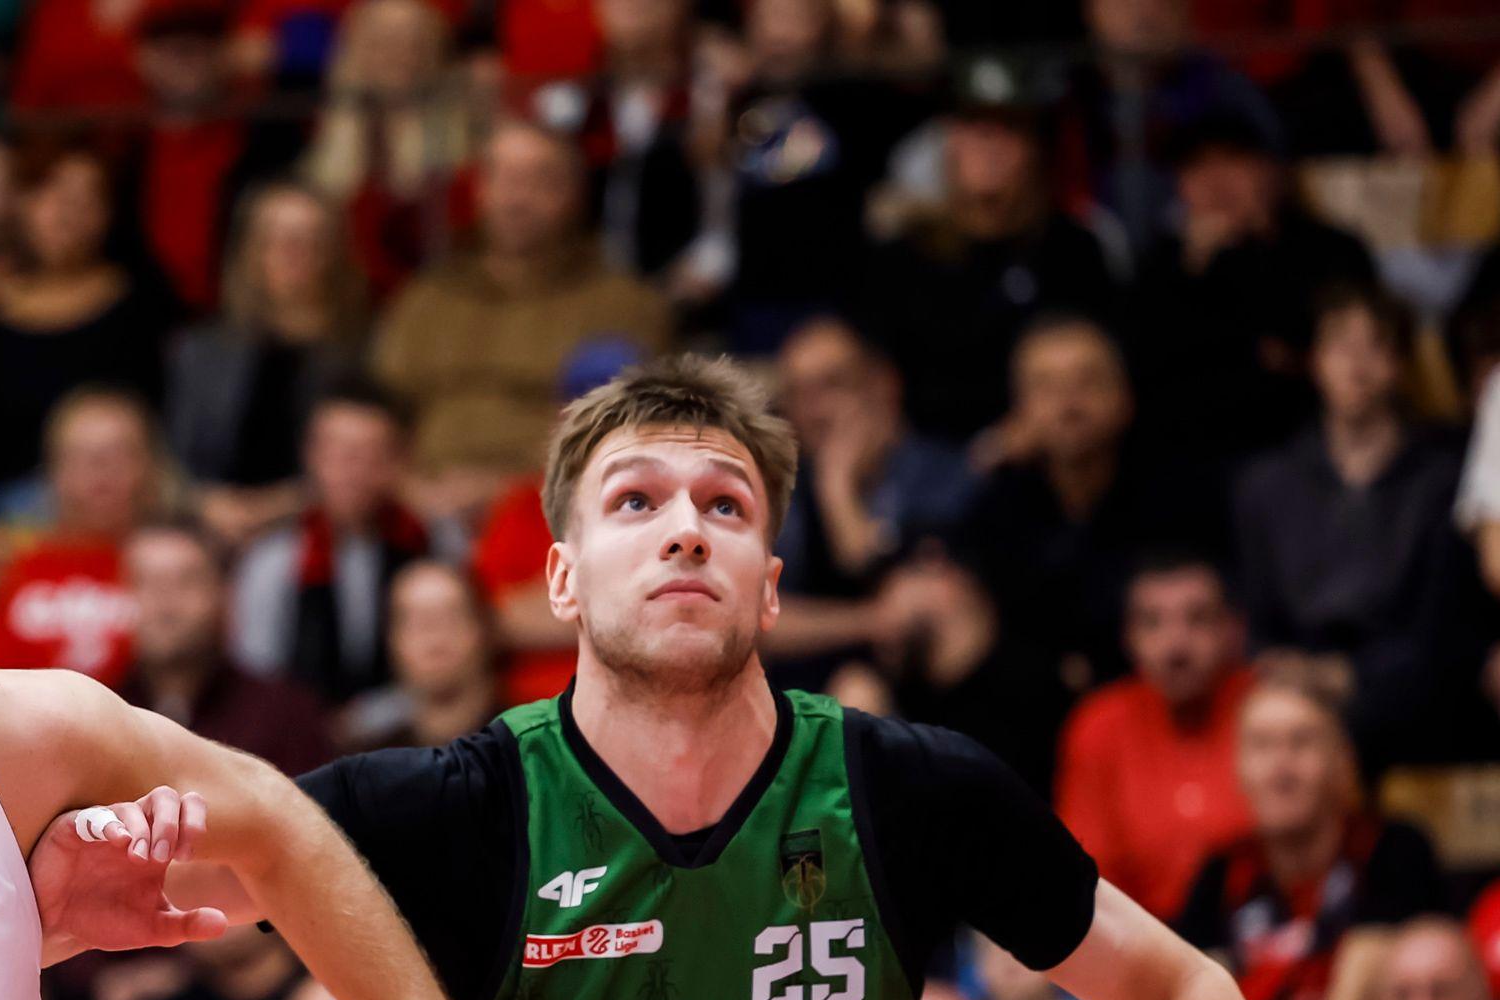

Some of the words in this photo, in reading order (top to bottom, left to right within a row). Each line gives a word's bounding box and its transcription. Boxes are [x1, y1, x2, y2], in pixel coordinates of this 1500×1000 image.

[537, 866, 608, 908] 4F
[526, 940, 576, 960] RLEN
[616, 925, 655, 939] Basket
[615, 941, 639, 953] Liga
